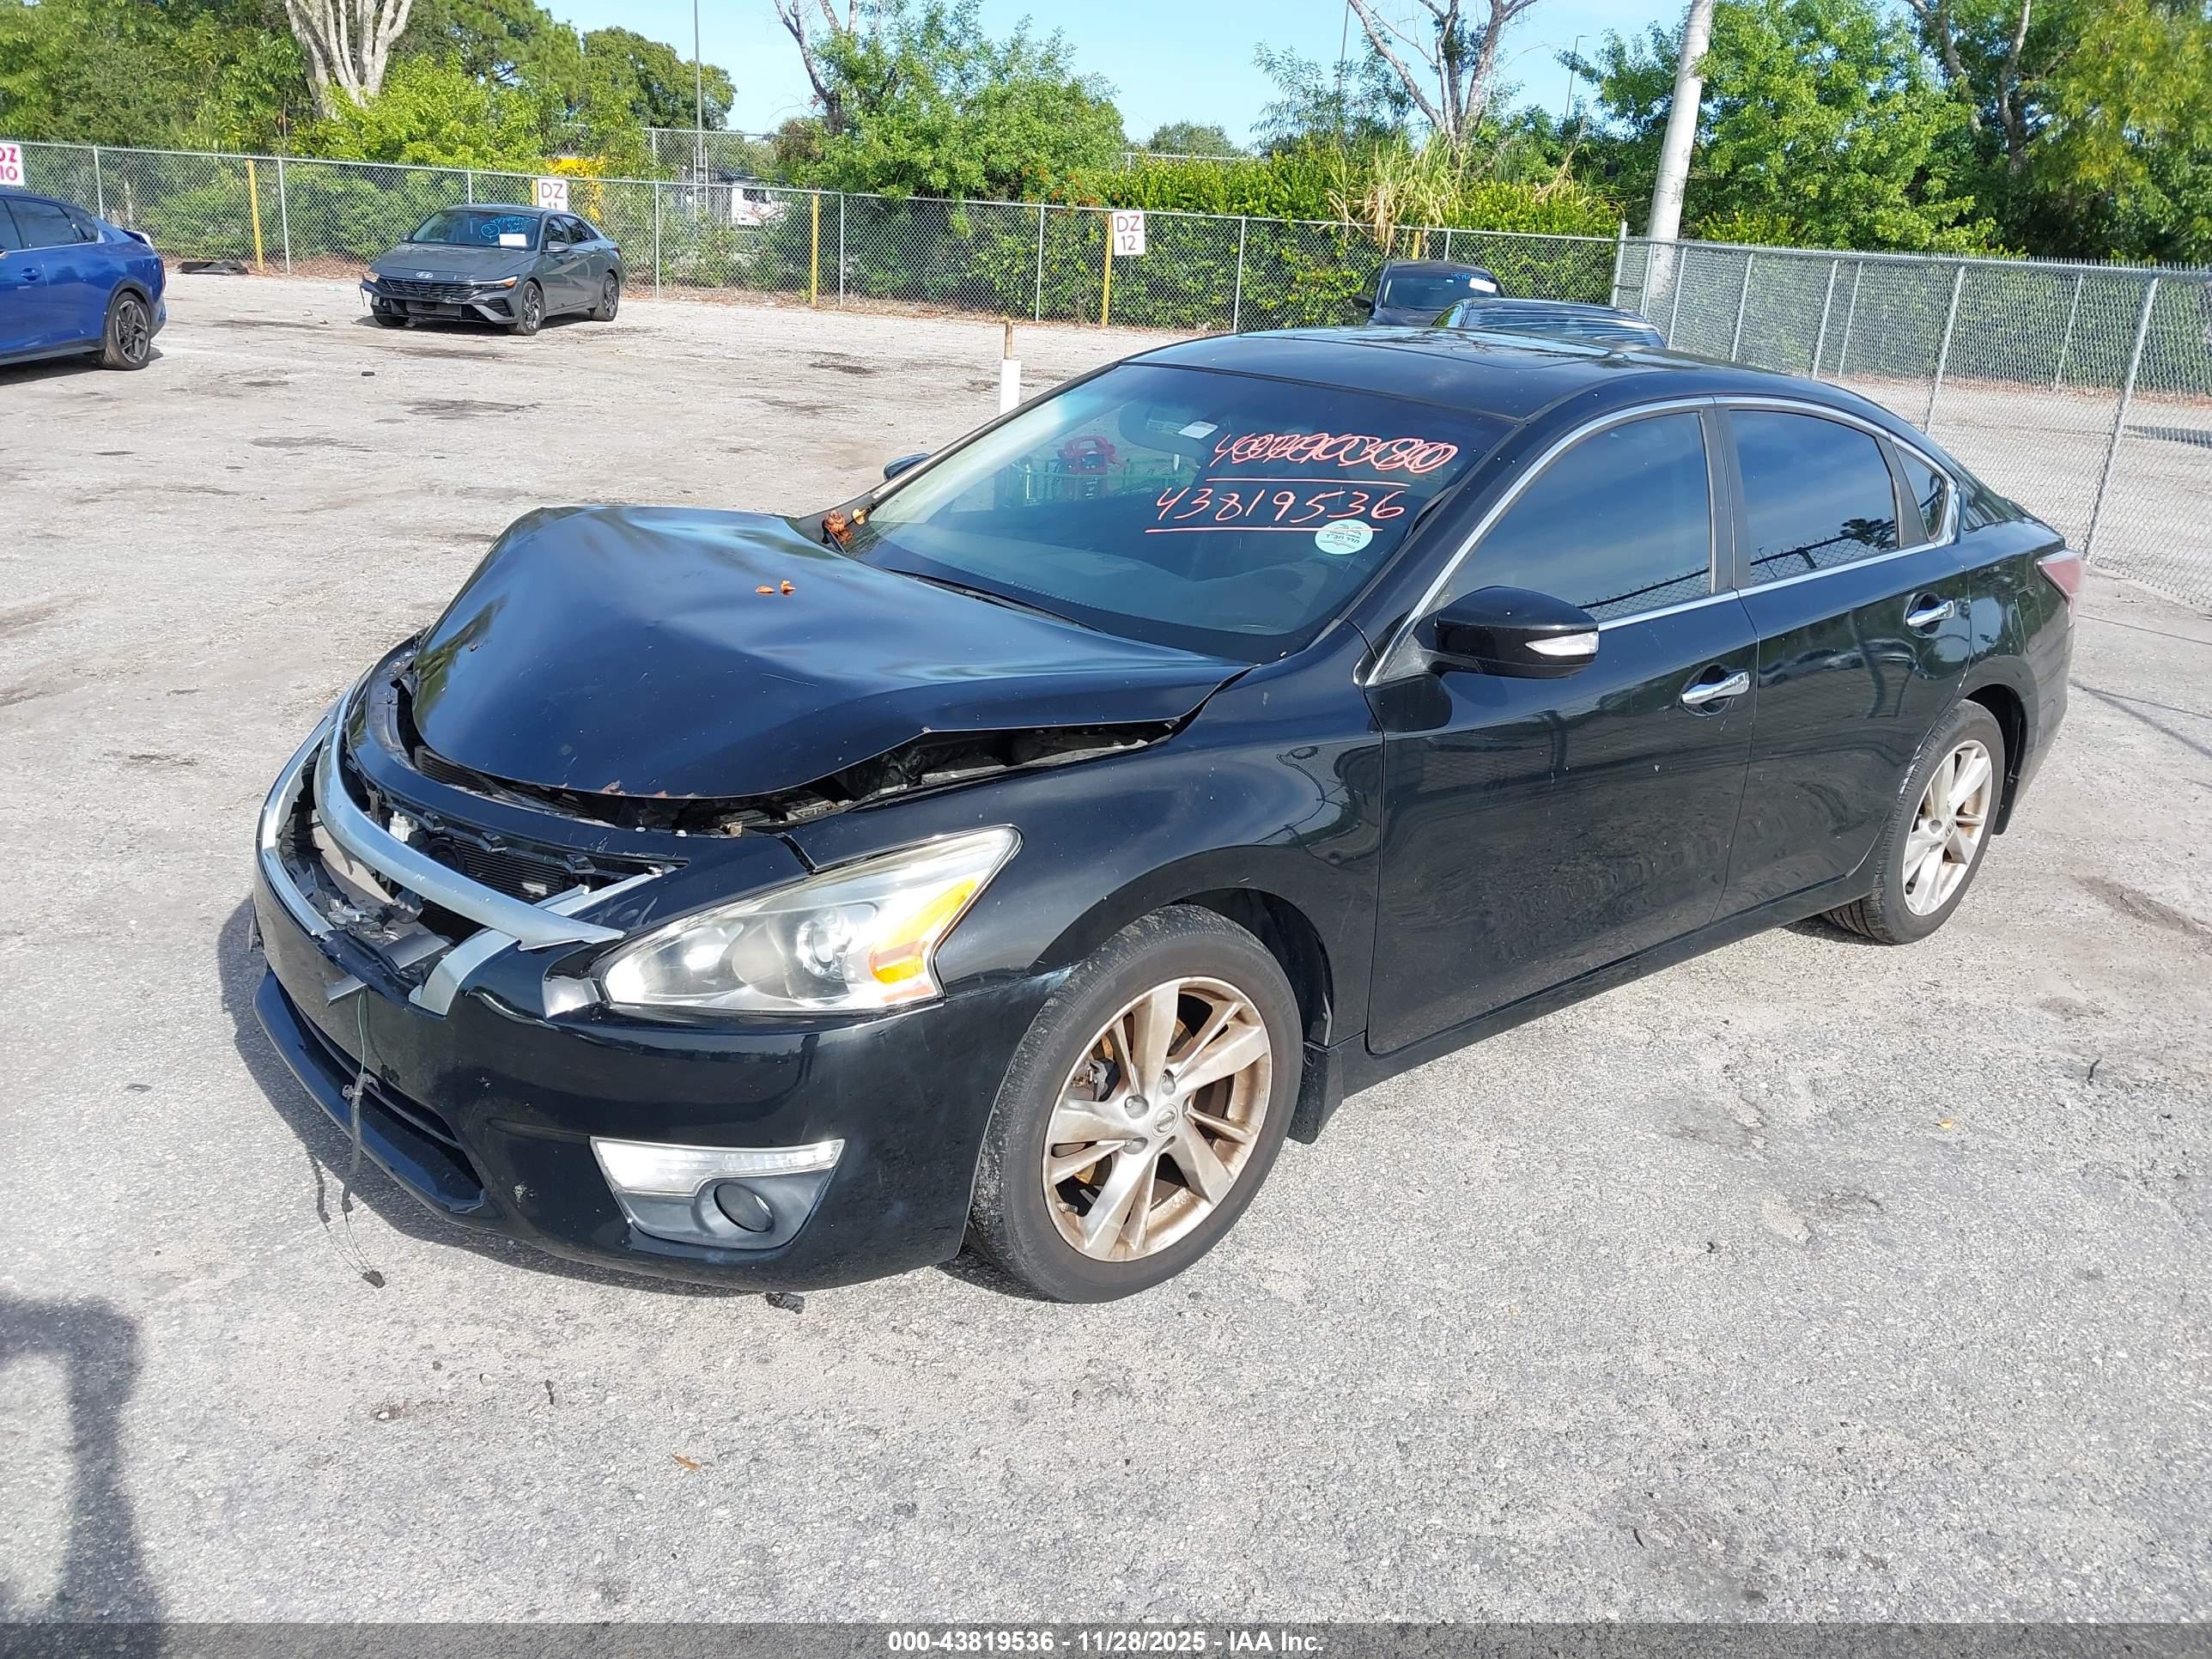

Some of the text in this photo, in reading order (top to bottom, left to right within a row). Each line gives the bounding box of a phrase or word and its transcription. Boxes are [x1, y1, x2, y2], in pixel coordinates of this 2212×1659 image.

[541, 182, 564, 199] DZ
[1116, 215, 1141, 233] DZ
[1121, 234, 1137, 252] 12
[1156, 486, 1407, 524] 43819536
